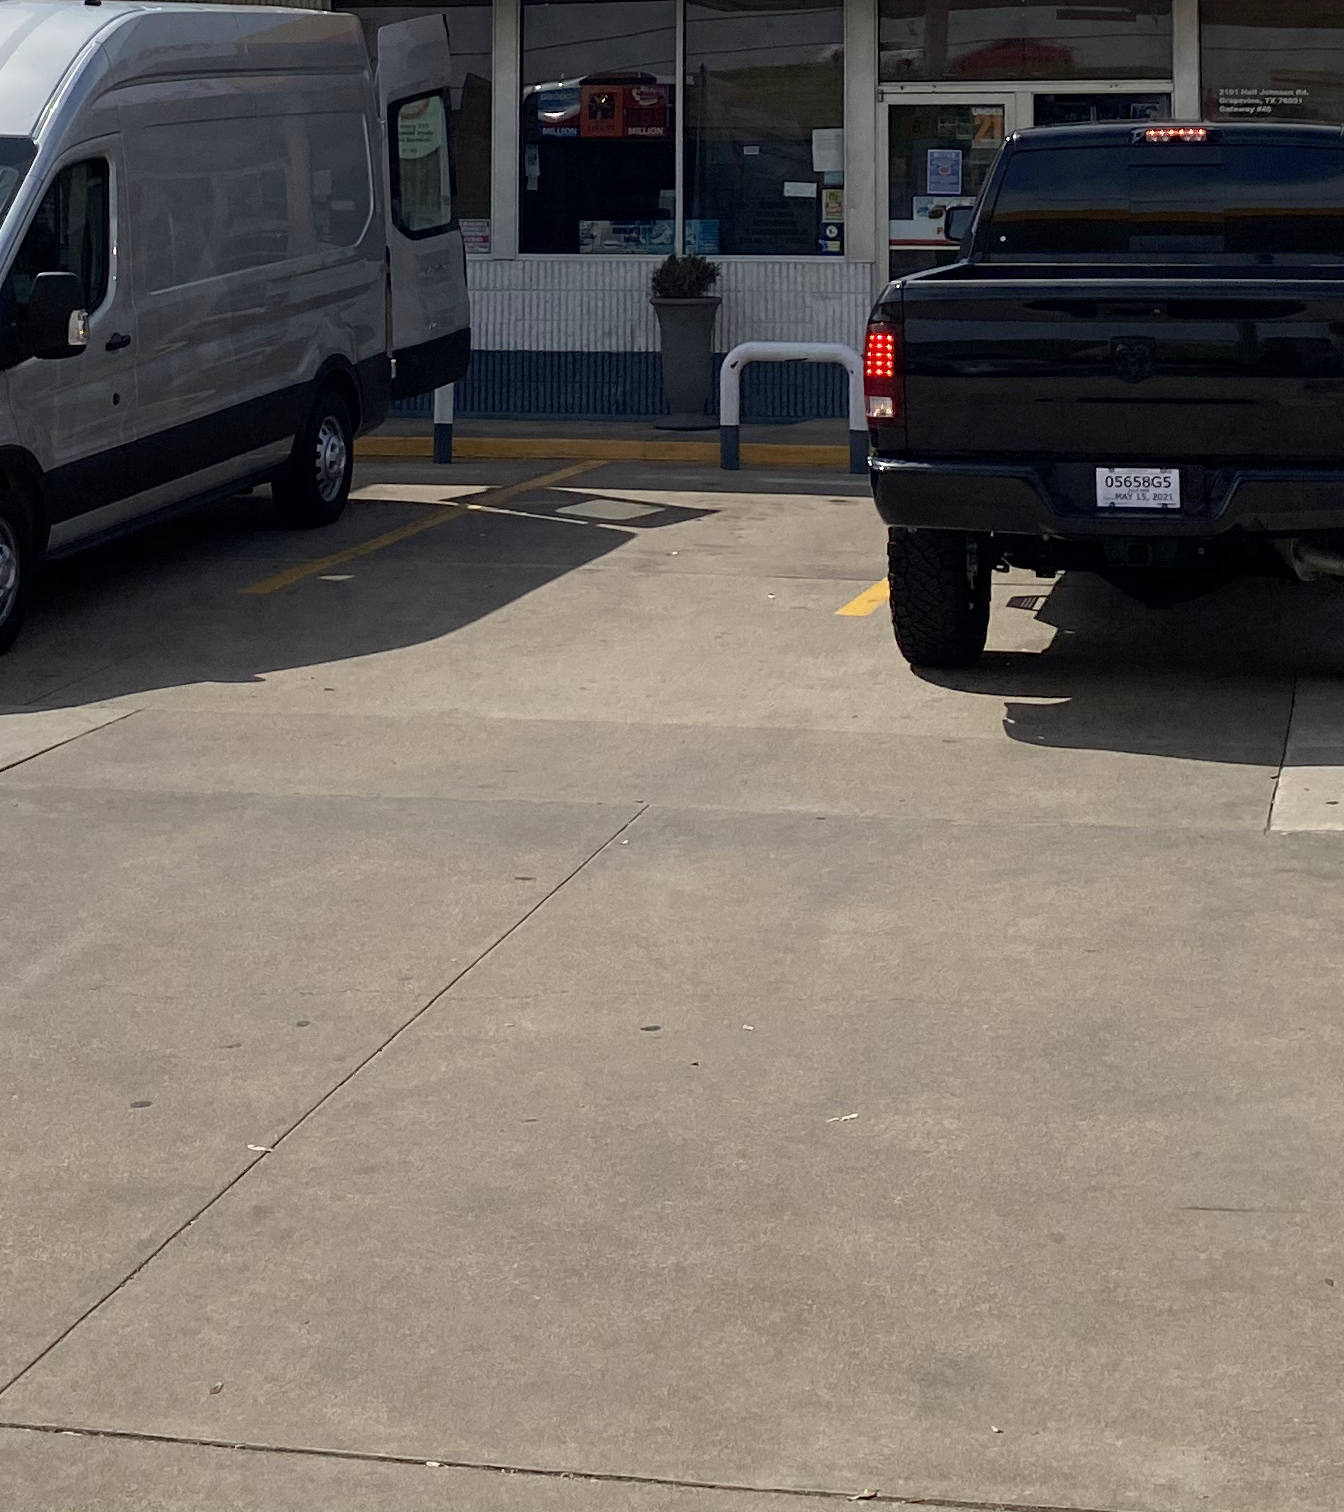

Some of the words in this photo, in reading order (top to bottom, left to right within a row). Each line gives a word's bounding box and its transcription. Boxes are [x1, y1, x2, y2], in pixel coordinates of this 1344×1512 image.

[542, 127, 578, 136] MILLION
[627, 126, 664, 136] MILLION
[1104, 475, 1173, 489] 05658G5
[1115, 493, 1134, 501] MAY
[1152, 493, 1174, 502] 2021
